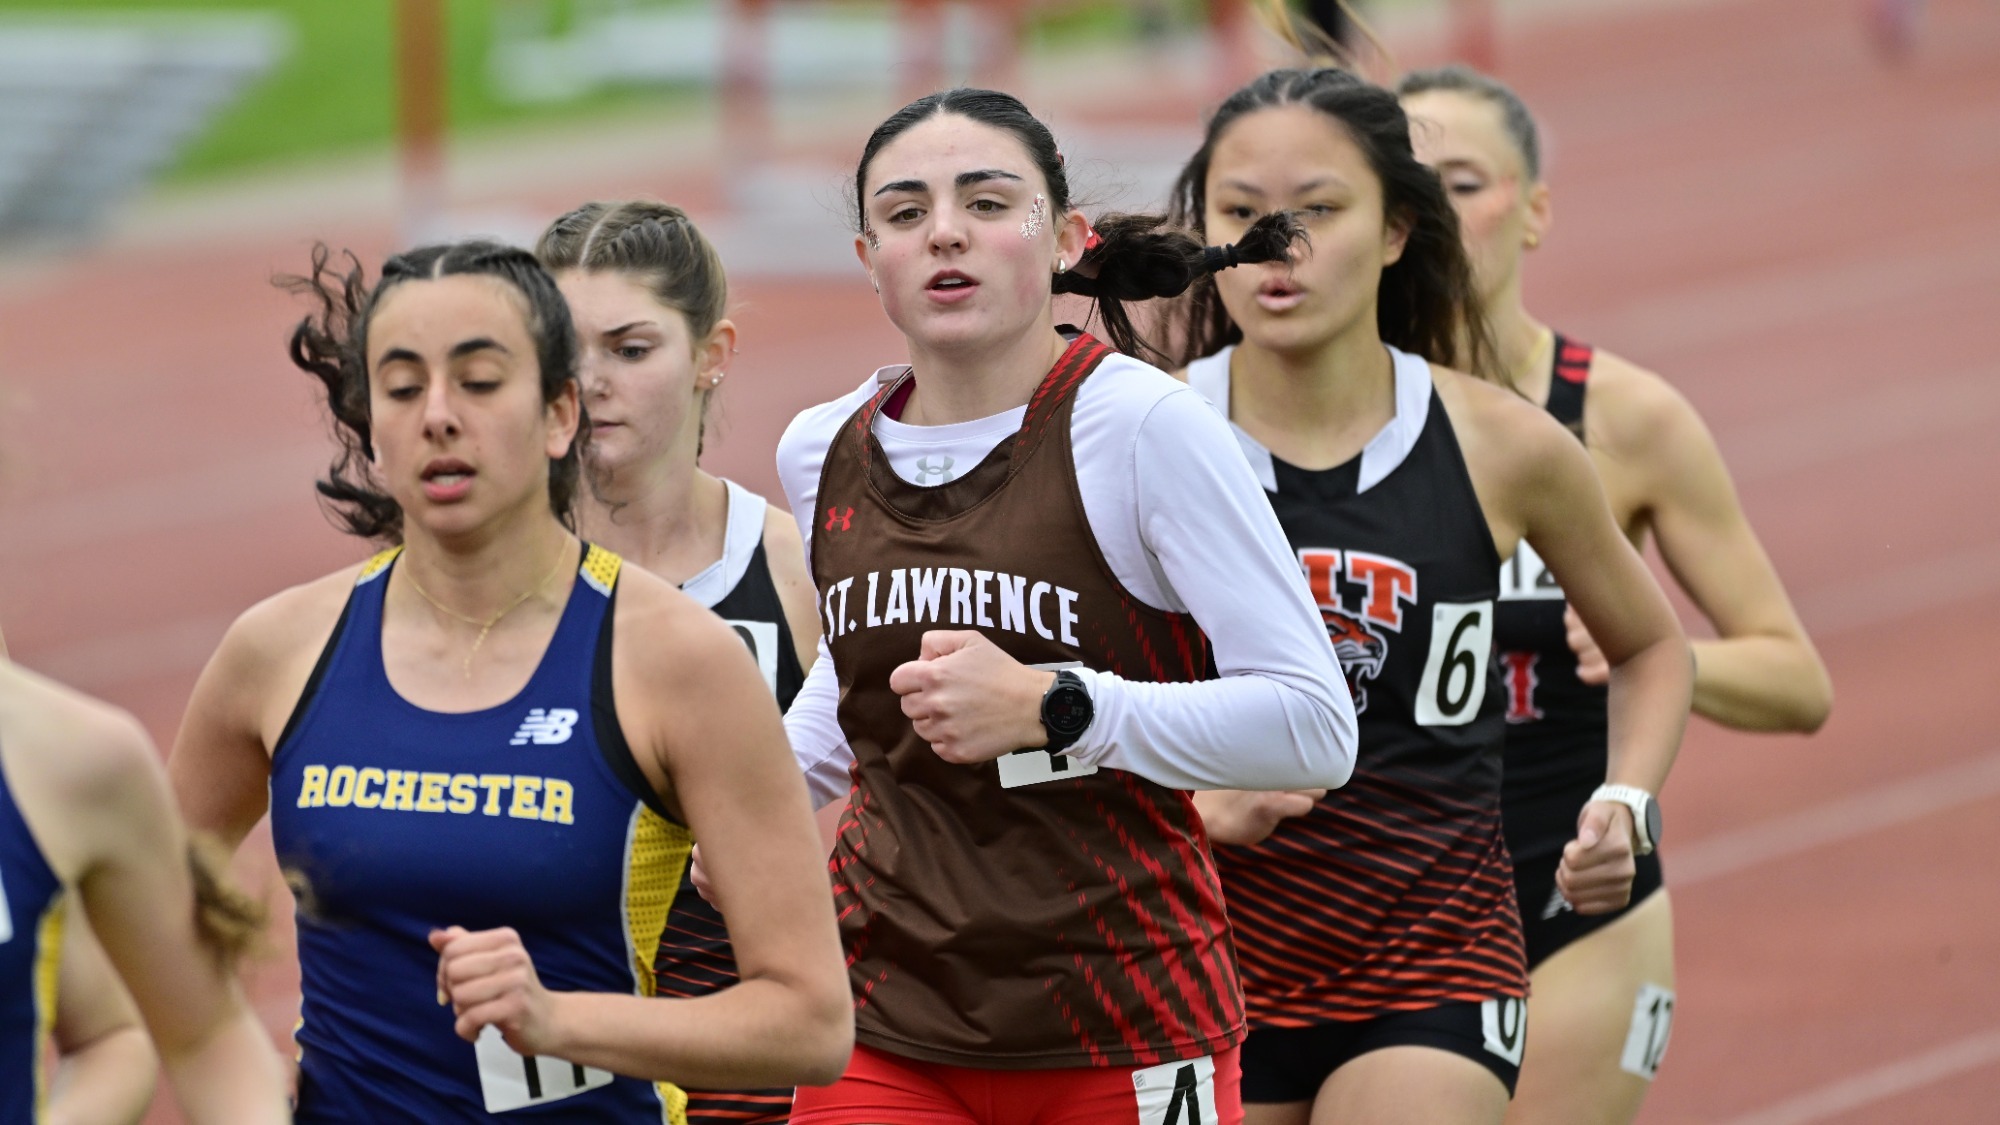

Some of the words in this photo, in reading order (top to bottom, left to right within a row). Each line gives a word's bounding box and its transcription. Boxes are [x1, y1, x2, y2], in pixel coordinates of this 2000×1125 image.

[825, 576, 858, 645] ST.
[866, 567, 1080, 647] LAWRENCE
[1436, 610, 1482, 717] 6
[296, 764, 575, 825] ROCHESTER
